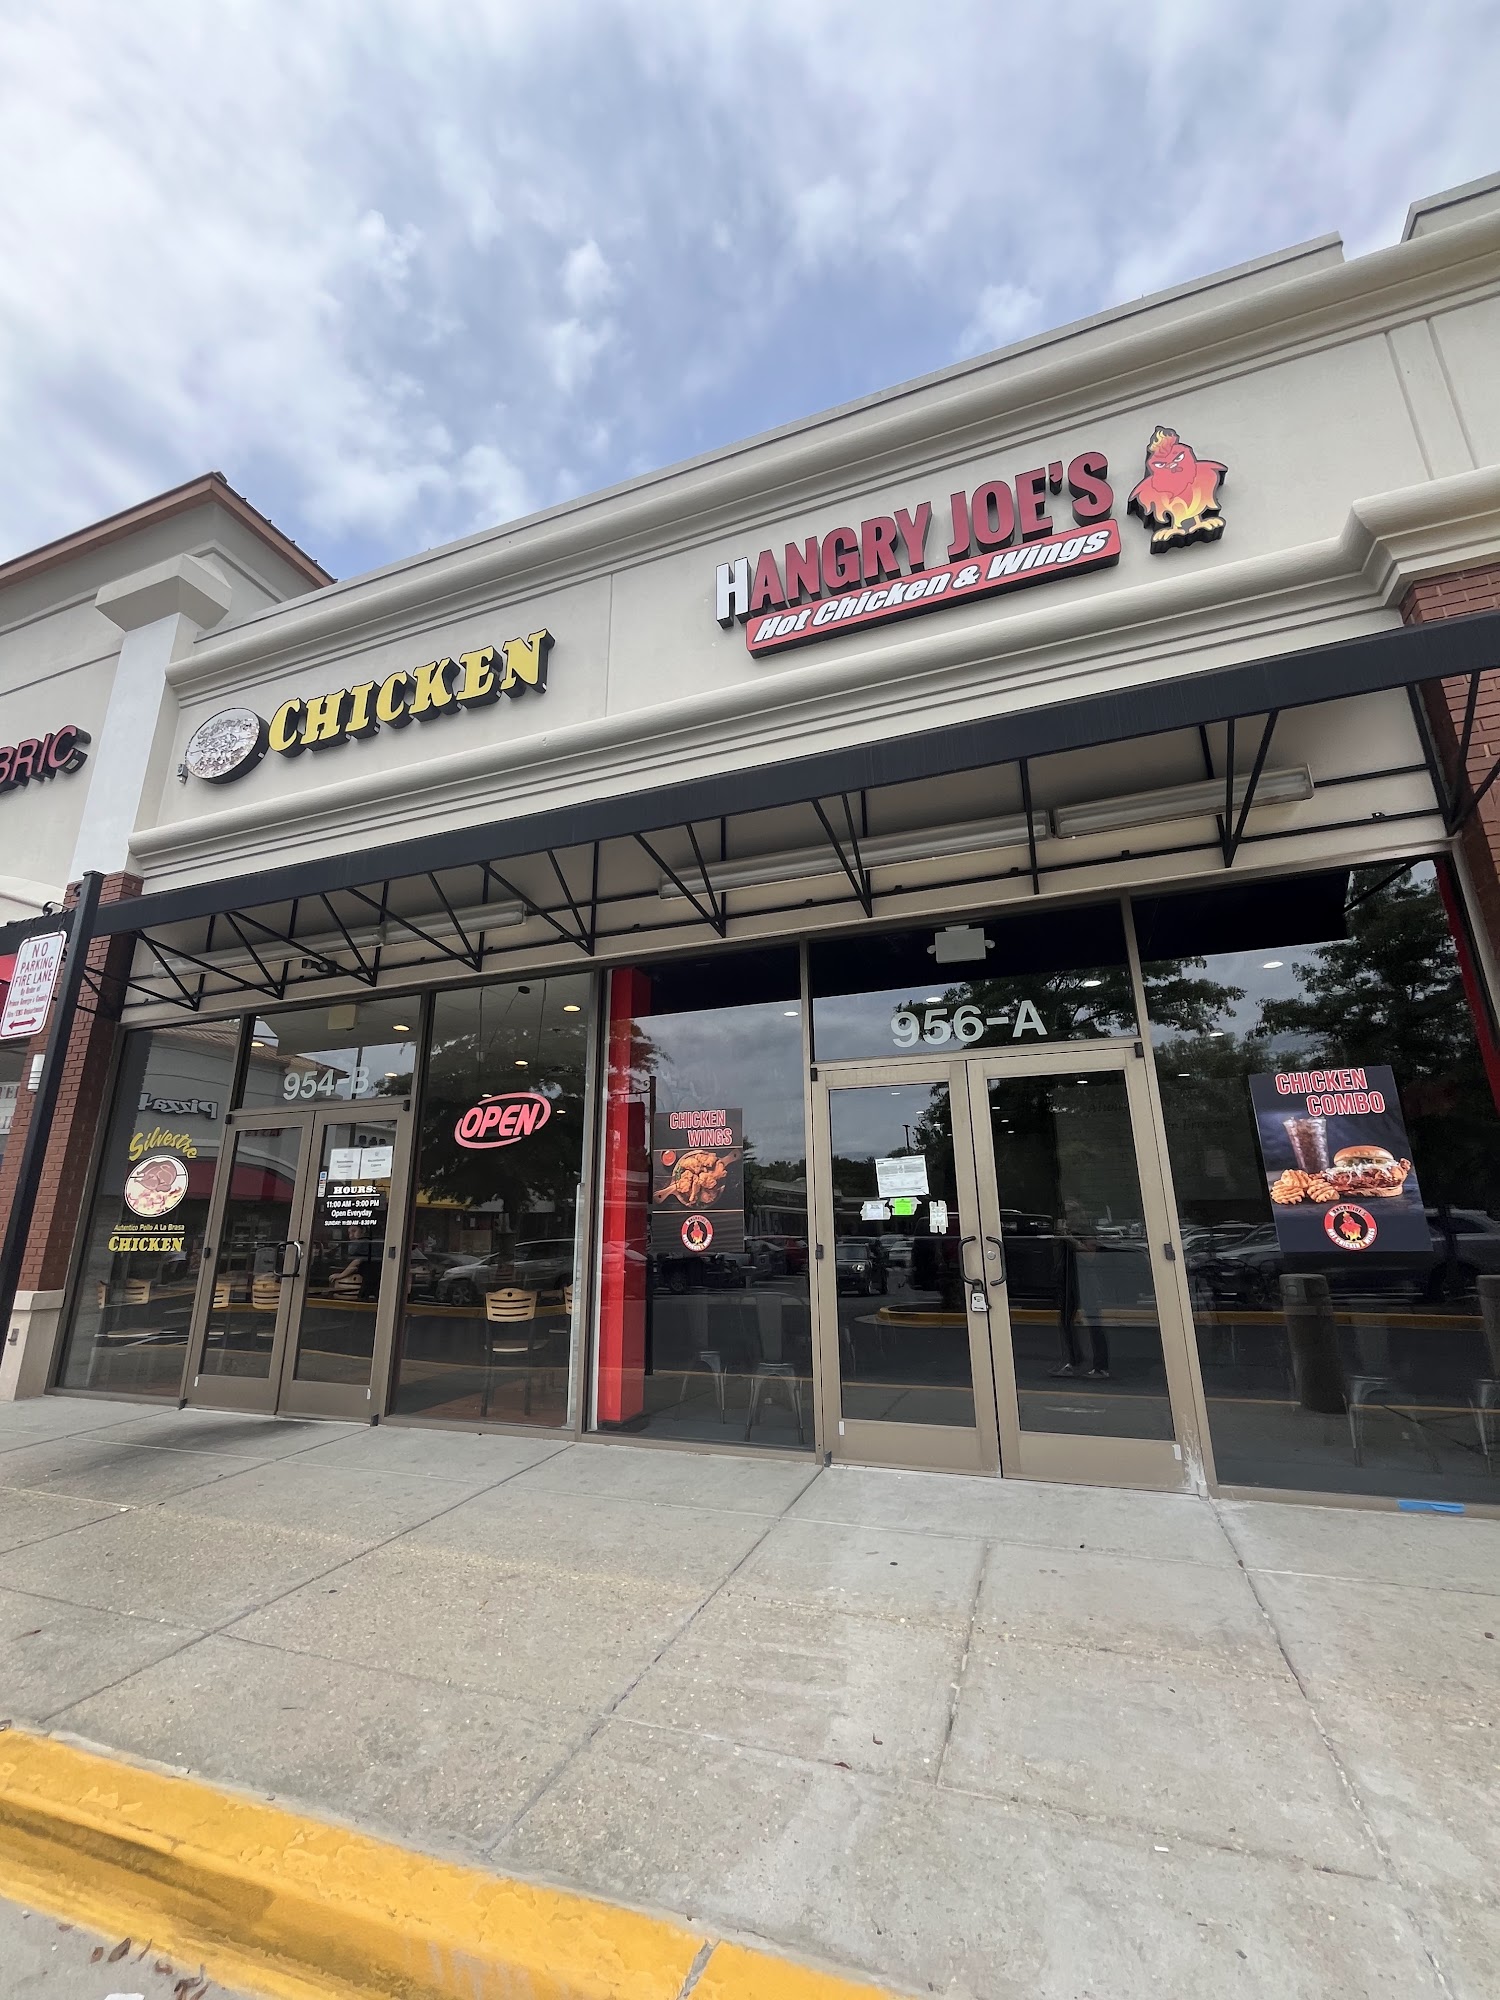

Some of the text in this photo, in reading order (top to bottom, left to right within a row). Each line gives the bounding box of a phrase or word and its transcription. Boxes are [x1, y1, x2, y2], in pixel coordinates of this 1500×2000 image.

[716, 451, 1114, 621] HANGRY JOE'S
[752, 529, 1112, 643] Hot Chicken & Wings
[268, 628, 550, 753] CHICKEN
[32, 941, 49, 959] NO
[20, 957, 54, 974] PARKING
[14, 969, 53, 988] FIRE LANE
[890, 999, 1048, 1048] 956-A
[283, 1066, 369, 1100] 954-B
[1275, 1068, 1368, 1095] CHICKEN
[1306, 1091, 1385, 1117] COMBO
[460, 1103, 541, 1139] OPEN
[669, 1109, 726, 1129] CHICKEN
[128, 1127, 198, 1161] Silvestre
[687, 1128, 733, 1147] WINGS
[333, 1186, 377, 1194] HOURS:
[326, 1200, 341, 1208] 11:00
[341, 1200, 352, 1208] AM
[355, 1199, 369, 1207] 9:00
[369, 1199, 380, 1207] PM
[331, 1209, 372, 1218] Open Everyday
[159, 1223, 167, 1231] La
[167, 1223, 185, 1231] Brasa
[108, 1235, 185, 1252] CHICKEN
